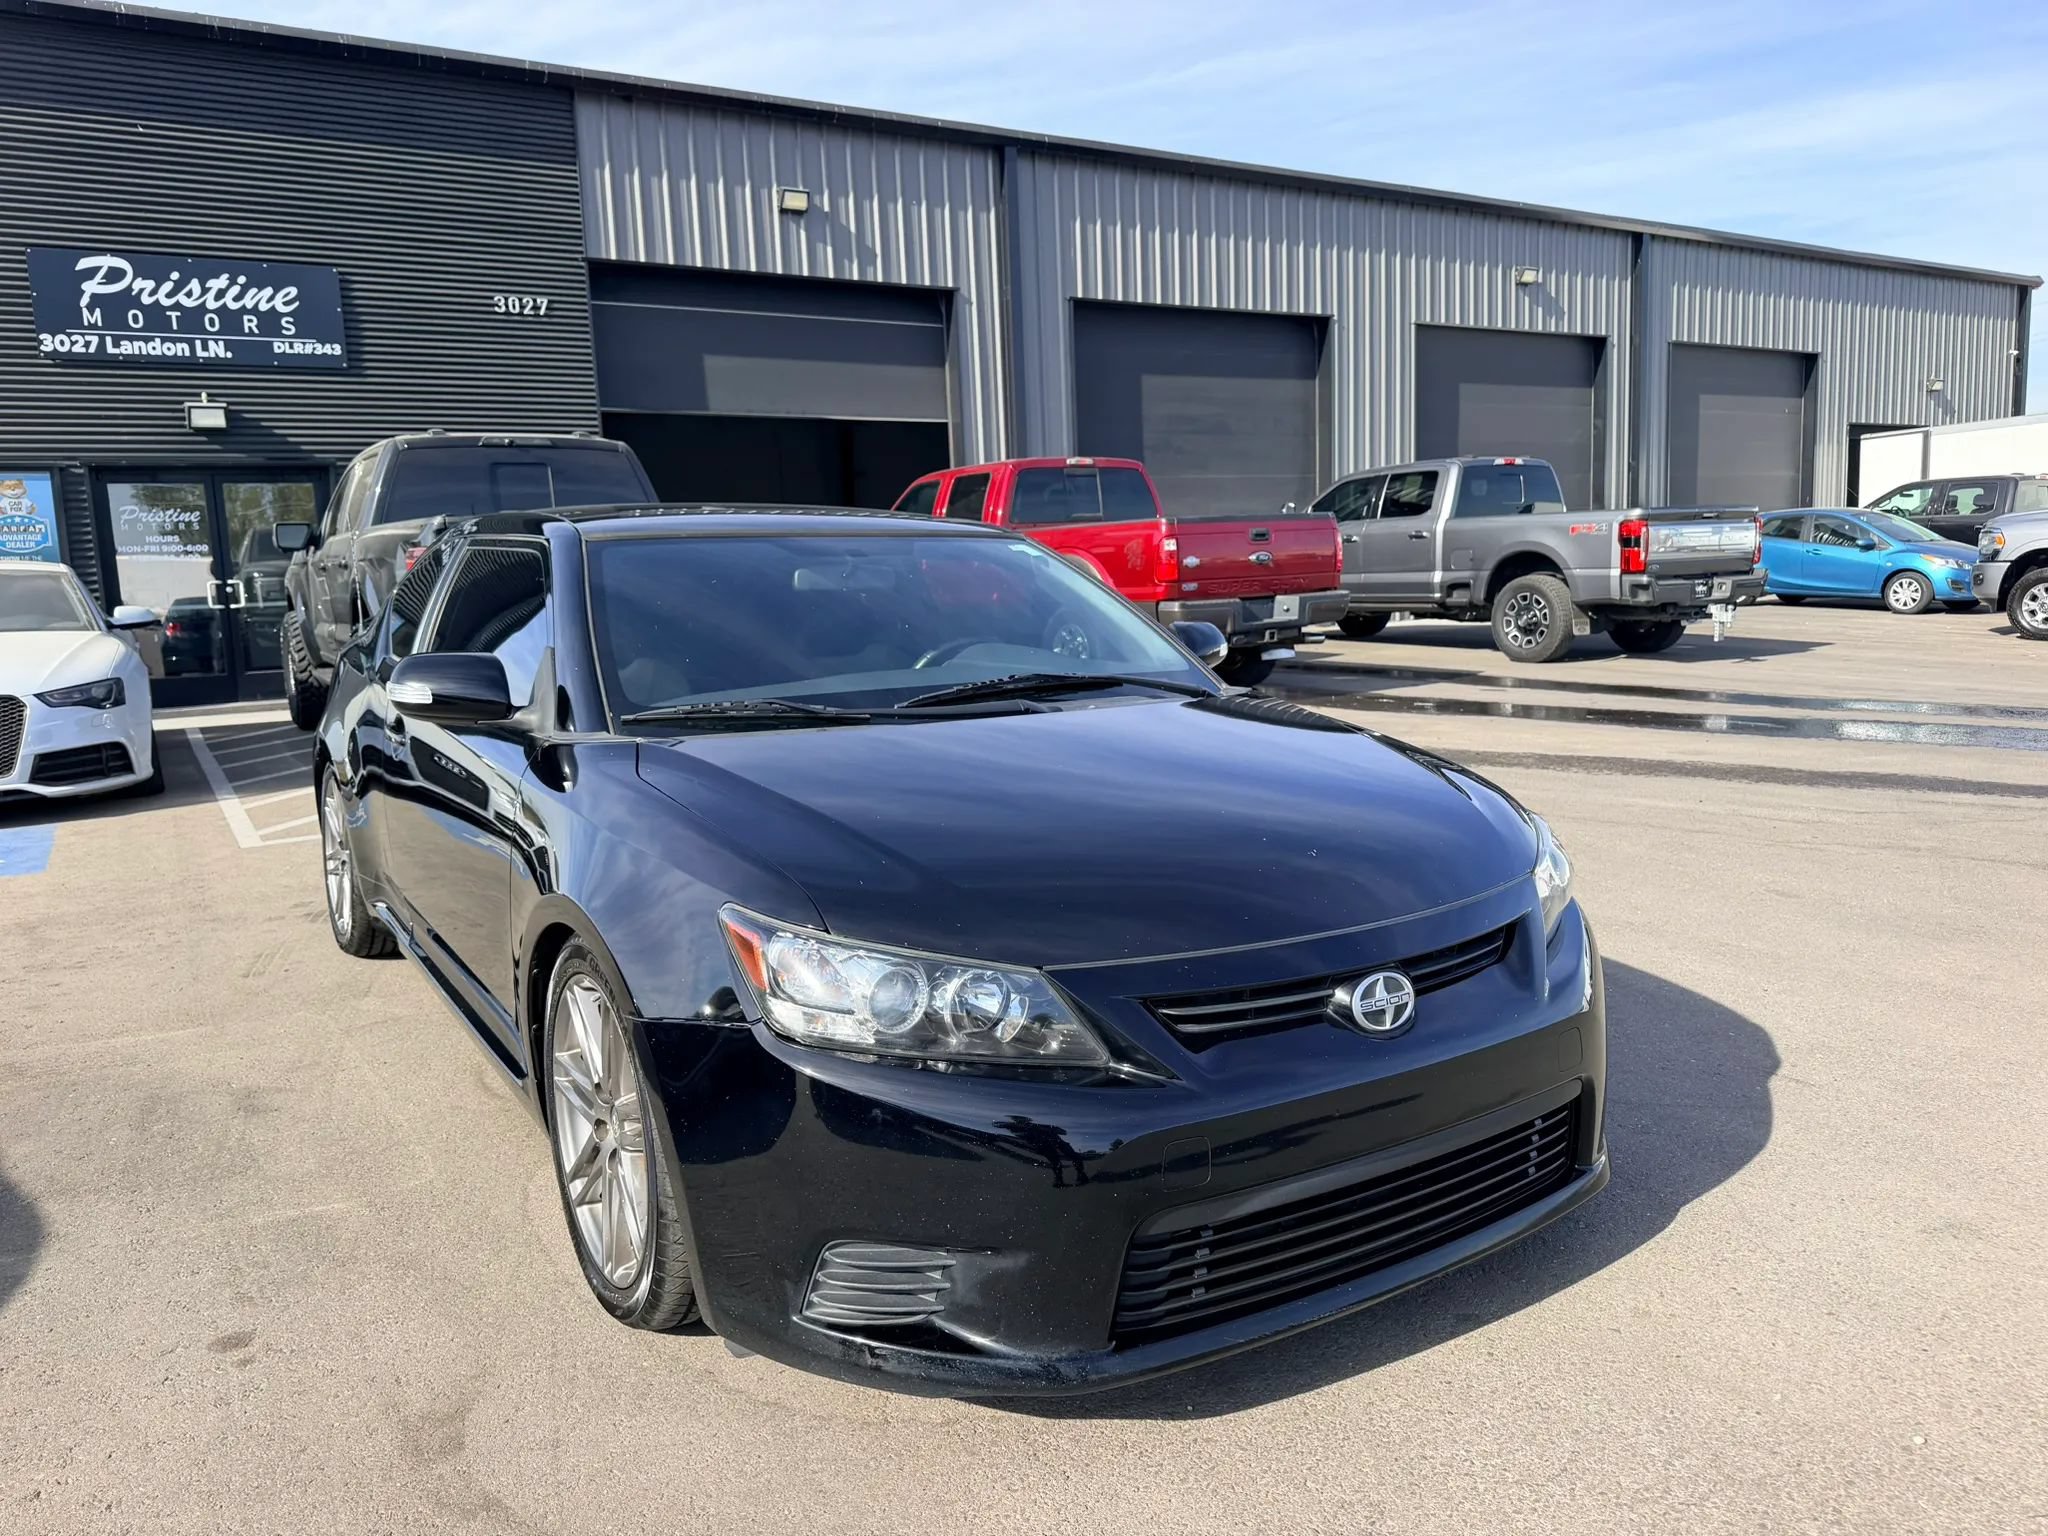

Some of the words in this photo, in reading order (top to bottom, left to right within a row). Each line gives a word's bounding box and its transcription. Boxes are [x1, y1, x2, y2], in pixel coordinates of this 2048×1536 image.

[75, 255, 300, 313] Pristine
[493, 295, 549, 316] 3027
[82, 307, 296, 335] MOTORS
[38, 333, 99, 353] 3027
[105, 335, 191, 357] Landon
[195, 339, 233, 359] LN.
[272, 341, 343, 356] DLR#343
[119, 505, 201, 524] Pristine
[0, 523, 45, 533] ARFAX
[121, 522, 200, 531] MOTORS
[6, 541, 36, 549] DEALER
[145, 535, 180, 543] HOURS
[117, 545, 160, 553] MON-FRI
[161, 544, 209, 553] 9:00-6:00
[1207, 581, 1261, 594] SUPER
